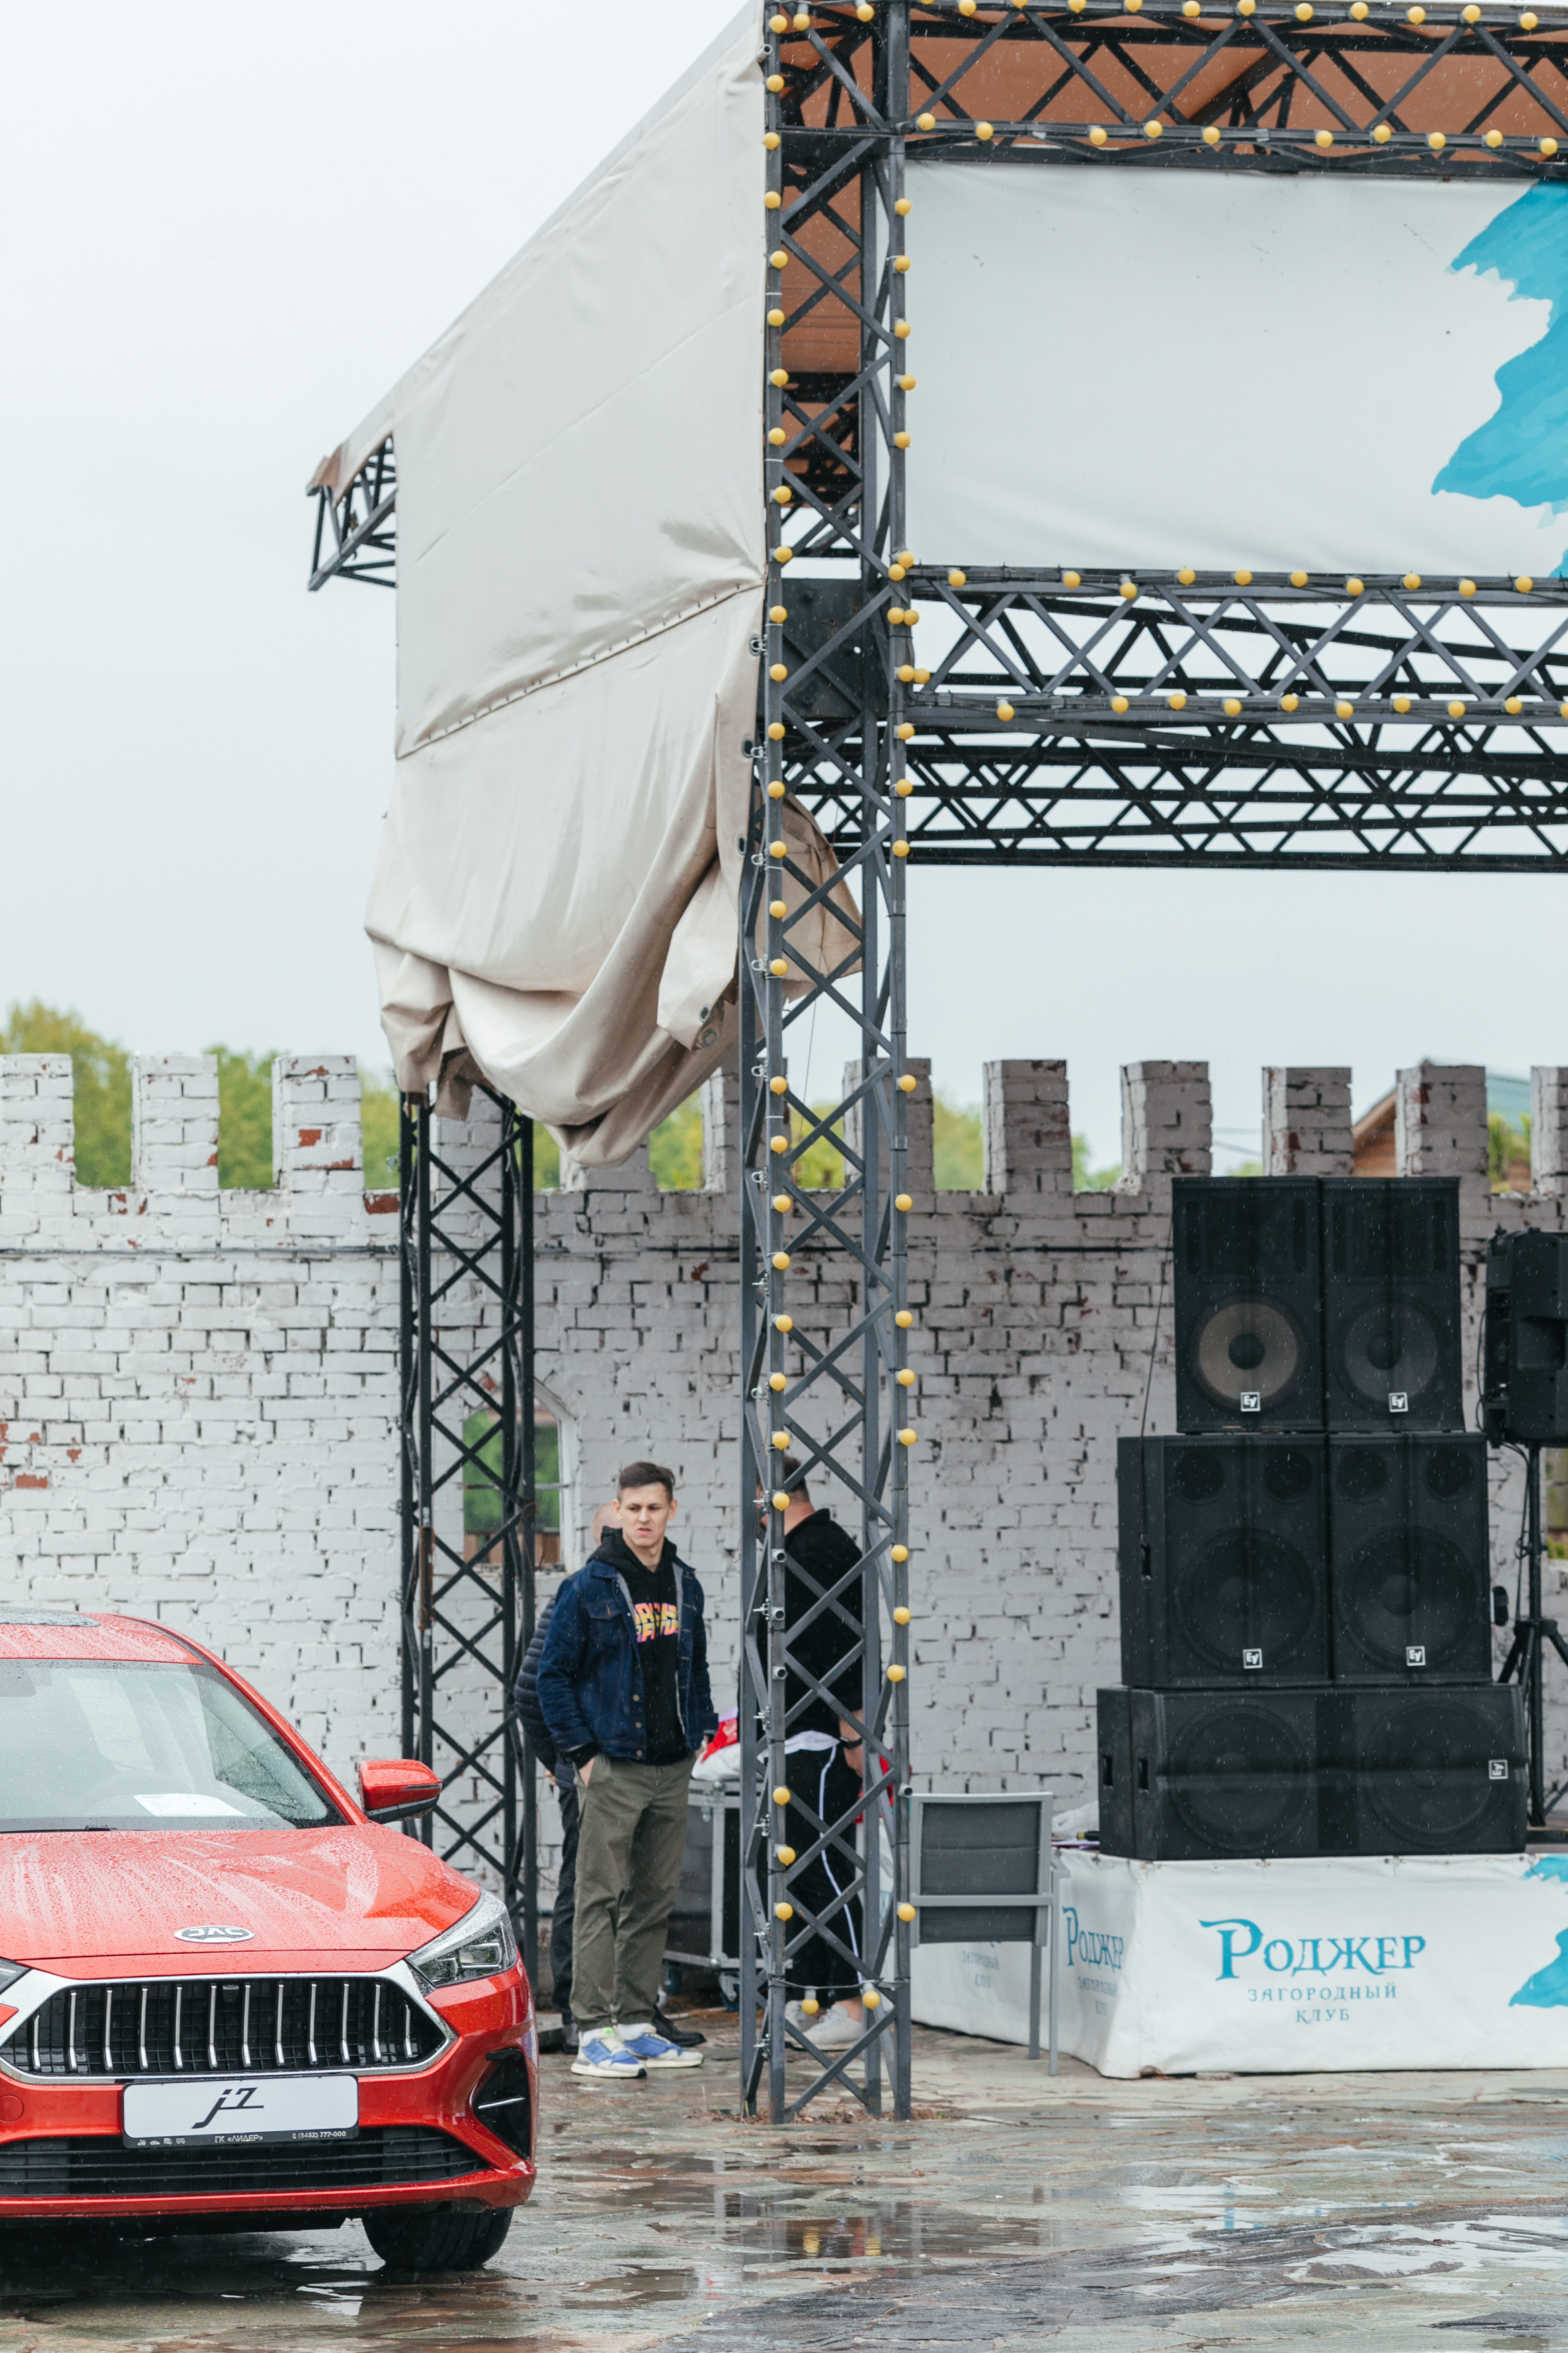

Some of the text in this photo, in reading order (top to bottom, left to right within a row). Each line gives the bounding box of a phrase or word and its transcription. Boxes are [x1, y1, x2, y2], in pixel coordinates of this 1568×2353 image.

[1198, 1919, 1426, 1981] РОДЖЕР
[1247, 1982, 1397, 2002] ЗАГОРОДНЫЙ
[1295, 2008, 1350, 2024] КЛУБ
[214, 2134, 263, 2143] ГК «ЛИДЕР»
